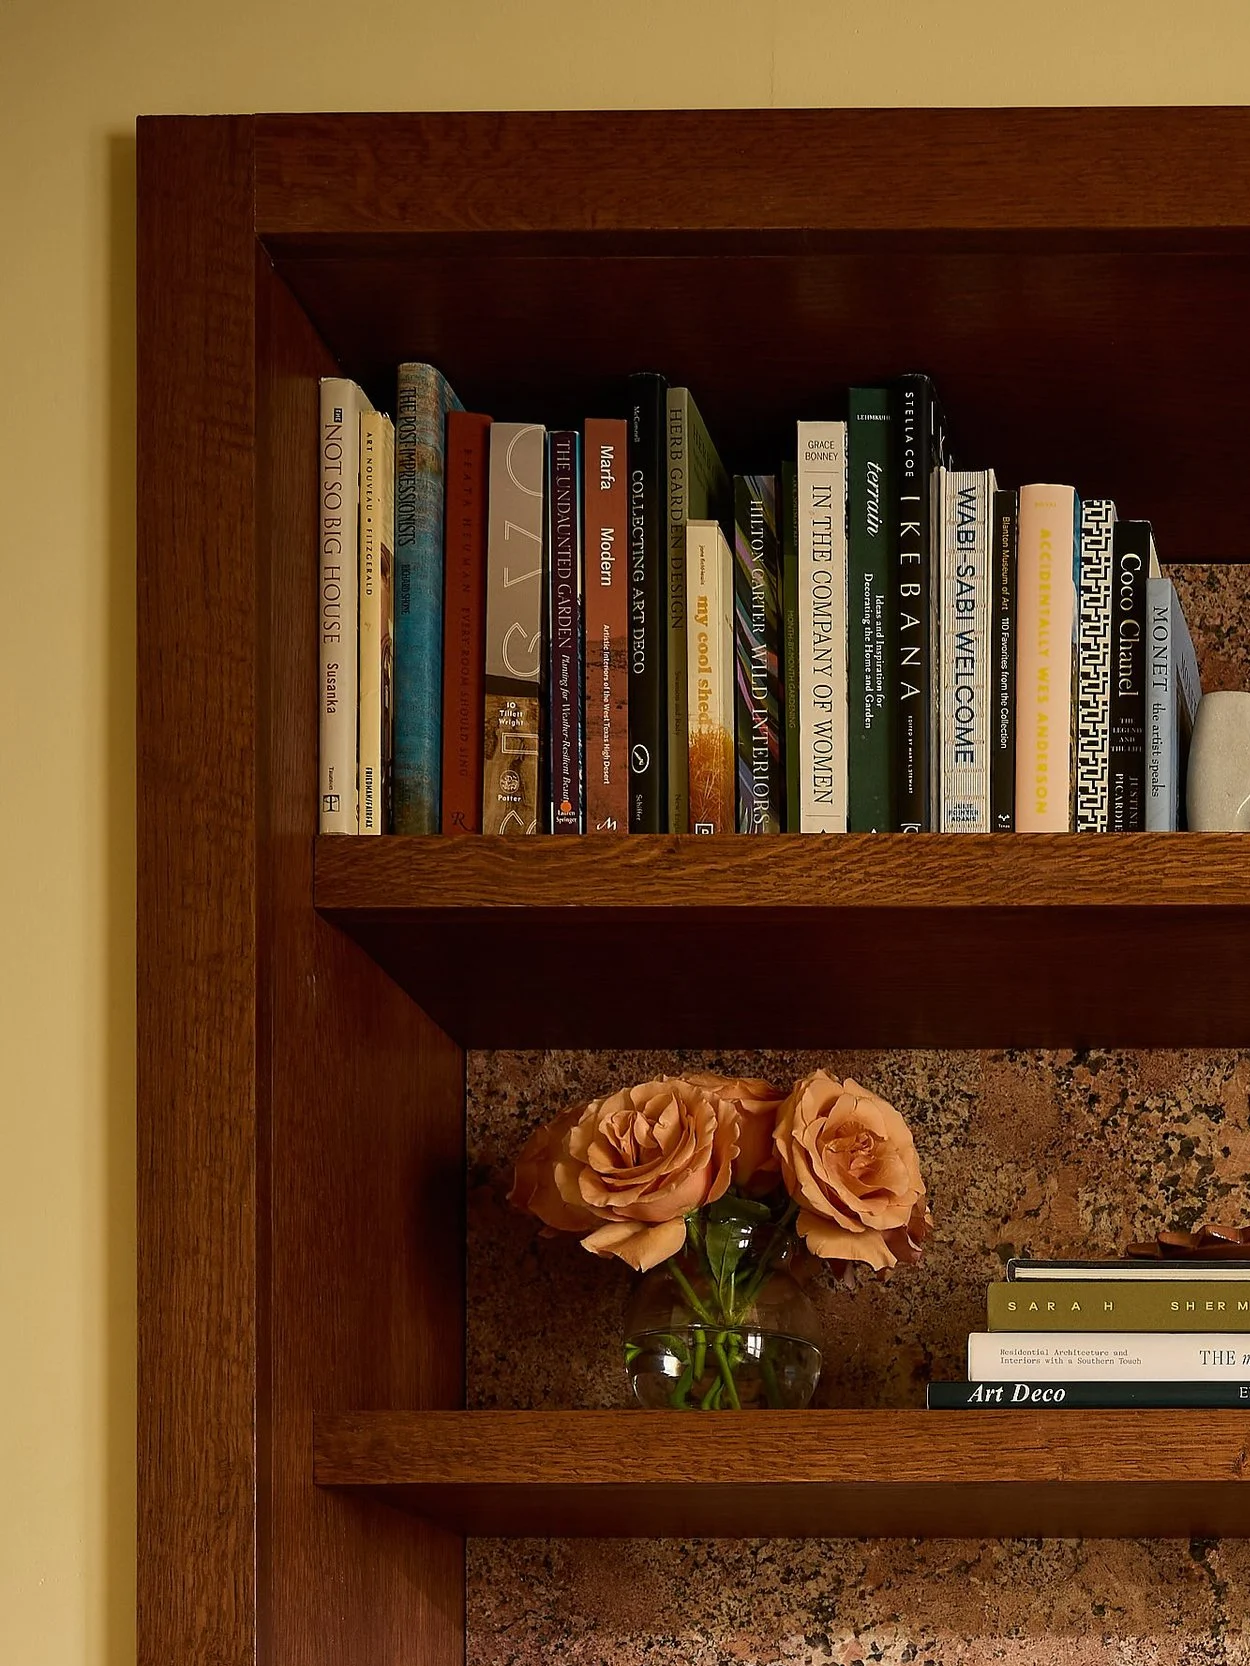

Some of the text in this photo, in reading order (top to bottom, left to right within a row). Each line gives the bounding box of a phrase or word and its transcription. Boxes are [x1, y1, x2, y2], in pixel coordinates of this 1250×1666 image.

[398, 386, 417, 547] THE POST-IMPRESSIONISTS
[805, 452, 838, 461] BONNEY
[808, 440, 835, 449] GRACE
[904, 392, 915, 477] STELLA COE
[322, 424, 342, 645] NOT SO BIG HOUSE
[365, 432, 374, 597] ART NOUVEAU FITZGERALD
[556, 440, 572, 649] THE UNDAUNTED GARDEN
[600, 445, 615, 586] Marfa Modern
[670, 408, 684, 630] HERB GARDEN DESIGN
[866, 460, 883, 538] terrain
[632, 470, 645, 674] COLLECTING ART DECO
[900, 495, 922, 701] IKEBANA
[1001, 516, 1010, 610] Blanton Museum of Art
[694, 595, 712, 725] my cool shed
[751, 500, 769, 825] HILTON CARTER WILD INTERIORS
[811, 485, 833, 805] IN THE COMPANY OF WOMEN
[862, 573, 874, 729] Decorating the Home and Garden
[874, 595, 886, 708] Ideas and Inspiration for
[954, 486, 977, 763] WABI-SABI WELCOME
[1036, 528, 1052, 815] ACCIDENTALLY WES ANDERSON
[1118, 553, 1142, 697] Coco Chanel
[1151, 606, 1168, 692] MONET
[326, 662, 339, 714] Susanka
[498, 719, 524, 727] Wright
[559, 654, 572, 775] Planting for Weather-Resilient
[603, 682, 611, 690] of
[603, 690, 611, 703] the
[1000, 617, 1010, 749] 110 Favorites from the Collection
[602, 743, 610, 760] High
[602, 761, 610, 784] Desert
[1148, 703, 1166, 797] the artist speaks
[497, 794, 522, 803] Potter
[635, 794, 643, 821] Schiffer
[1000, 1348, 1128, 1356] Residential Architecture and
[1008, 1301, 1114, 1311] SARAH
[967, 1383, 1066, 1402] Art Deco
[1000, 1357, 1041, 1365] Interiors
[1077, 1357, 1115, 1365] Southern
[1118, 1357, 1142, 1365] Touch
[1199, 1350, 1236, 1366] THE
